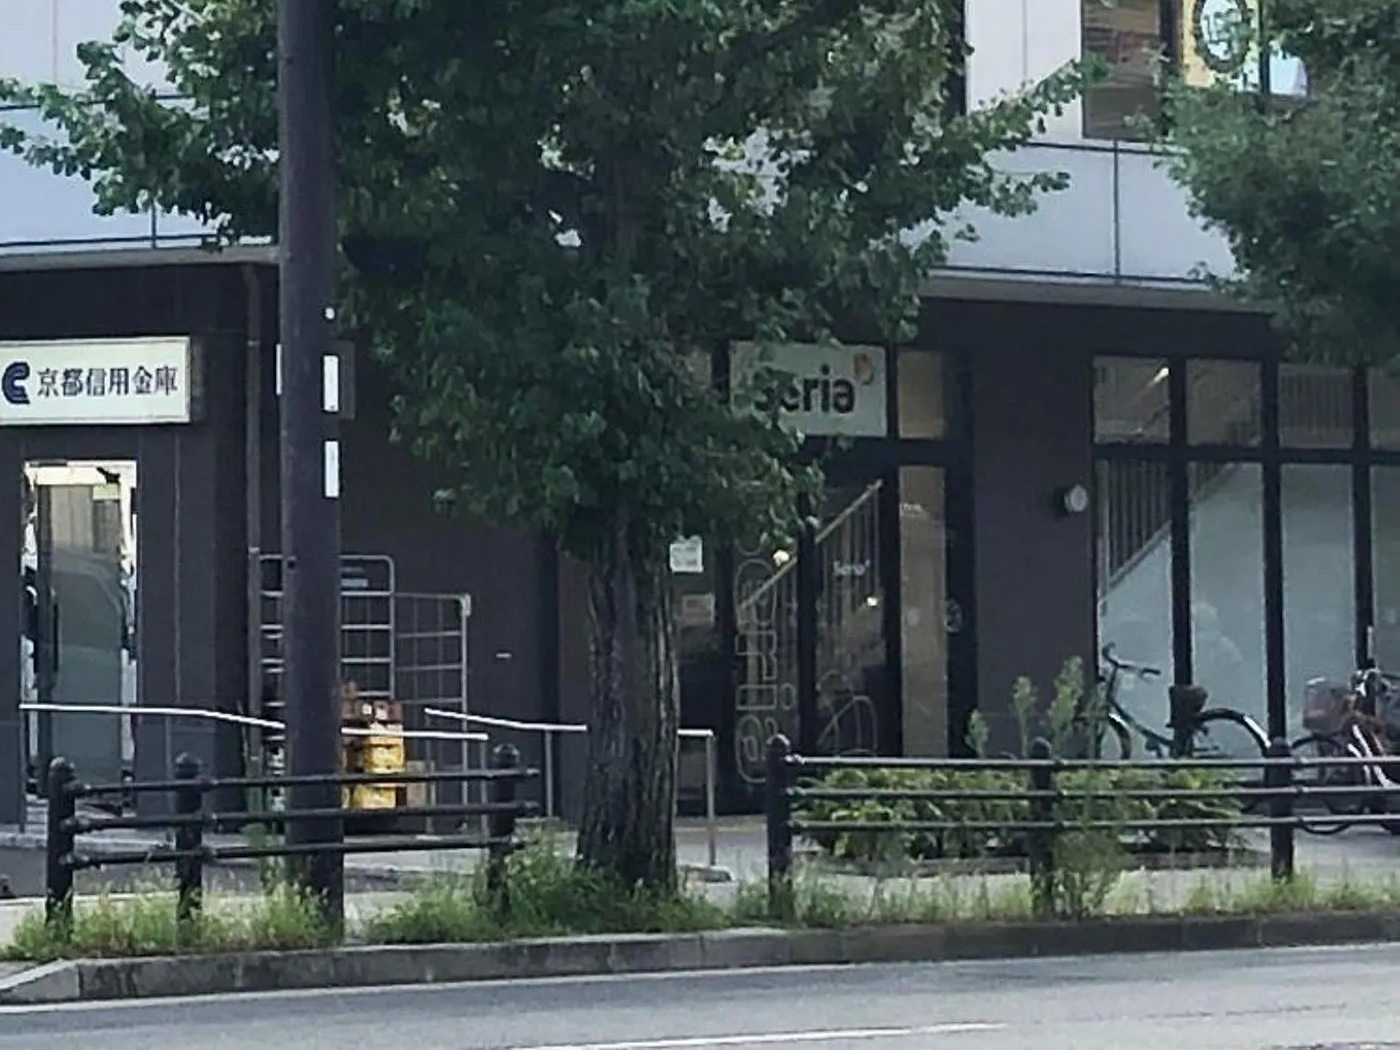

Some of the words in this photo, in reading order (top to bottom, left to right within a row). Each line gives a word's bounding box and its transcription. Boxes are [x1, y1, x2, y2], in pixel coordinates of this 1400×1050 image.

[36, 365, 178, 398] 京都信用金庫
